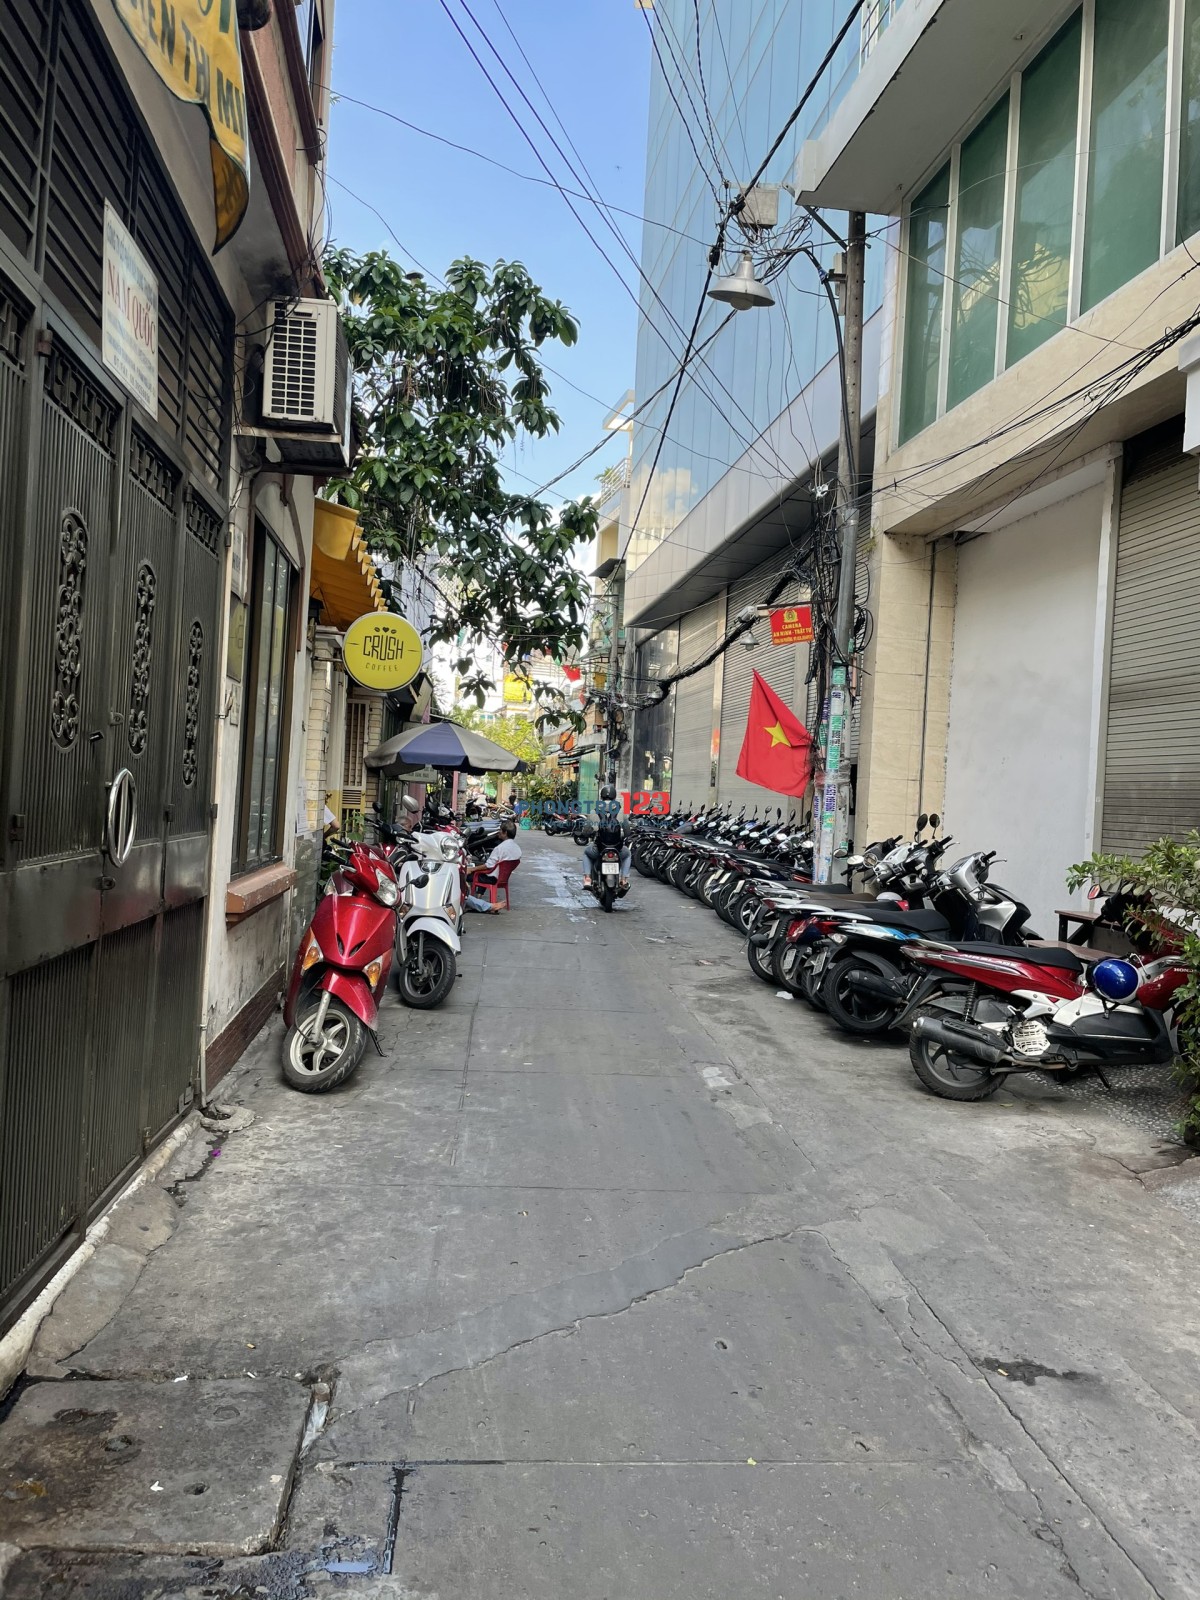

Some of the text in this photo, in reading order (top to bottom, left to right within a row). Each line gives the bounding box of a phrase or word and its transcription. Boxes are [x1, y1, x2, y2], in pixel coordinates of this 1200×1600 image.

[108, 259, 131, 321] NAM
[363, 635, 404, 661] CRUSH
[365, 662, 398, 672] COFFEE
